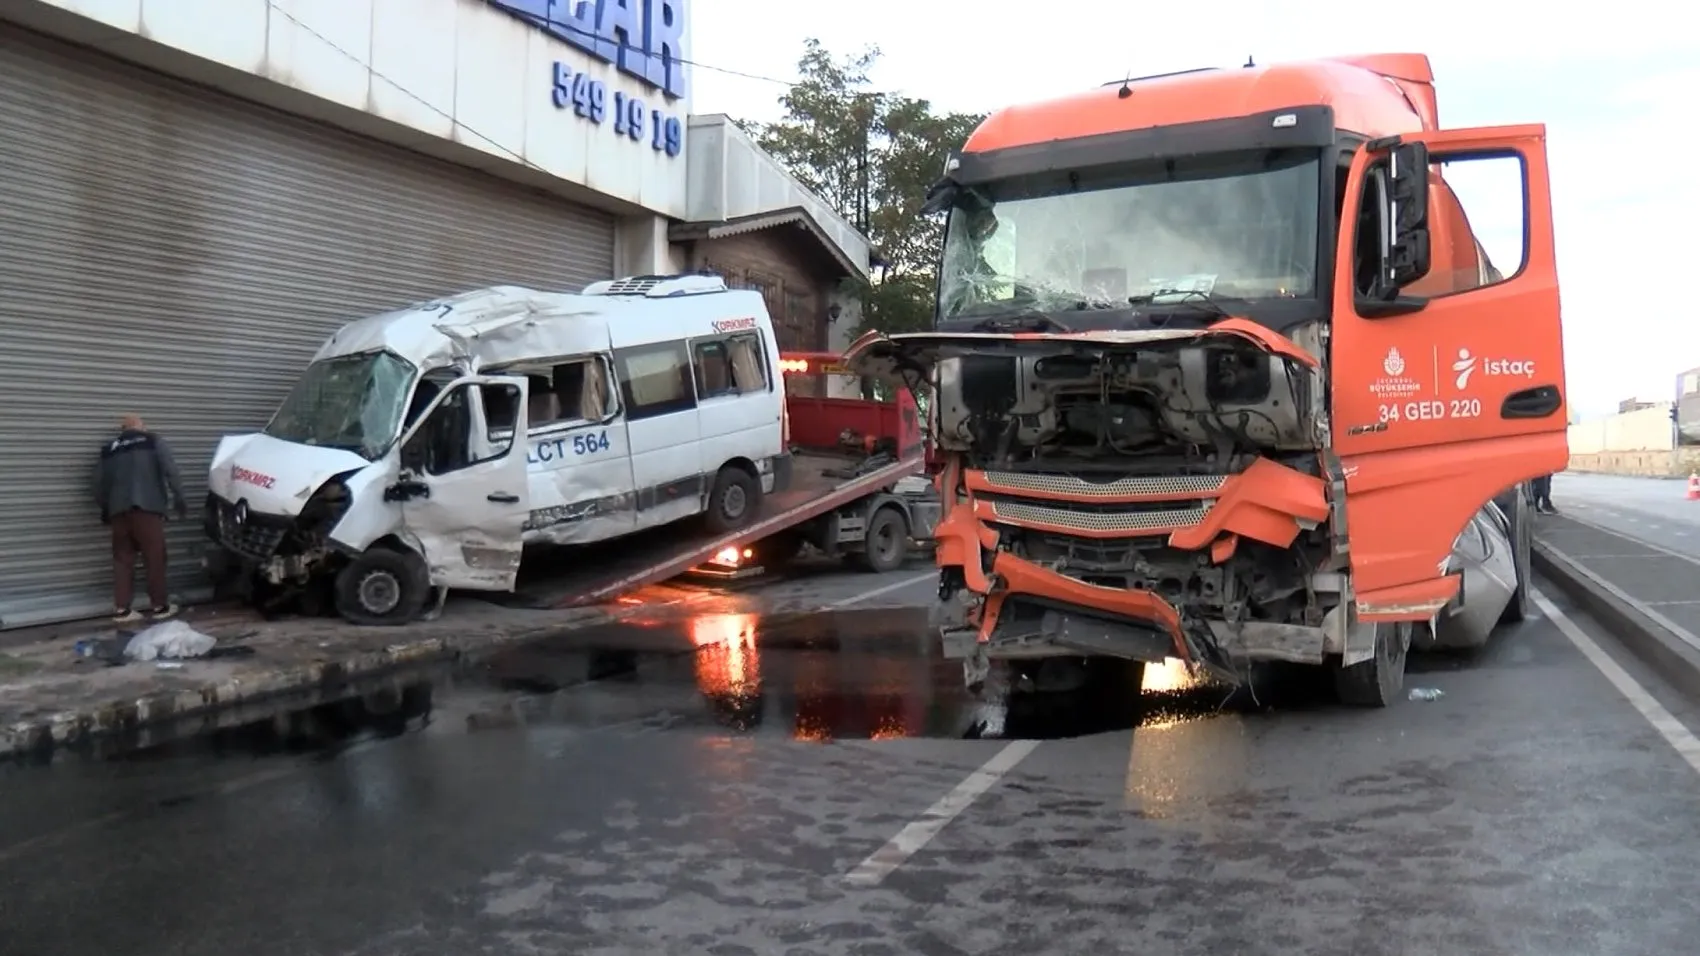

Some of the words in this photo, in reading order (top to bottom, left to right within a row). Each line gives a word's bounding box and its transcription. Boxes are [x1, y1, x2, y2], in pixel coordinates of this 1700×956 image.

[552, 61, 607, 124] 549
[614, 91, 646, 141] 19
[652, 109, 682, 157] 19
[1378, 404, 1401, 423] 34
[1405, 401, 1445, 421] GED
[1450, 398, 1482, 417] 220
[573, 430, 610, 455] 564
